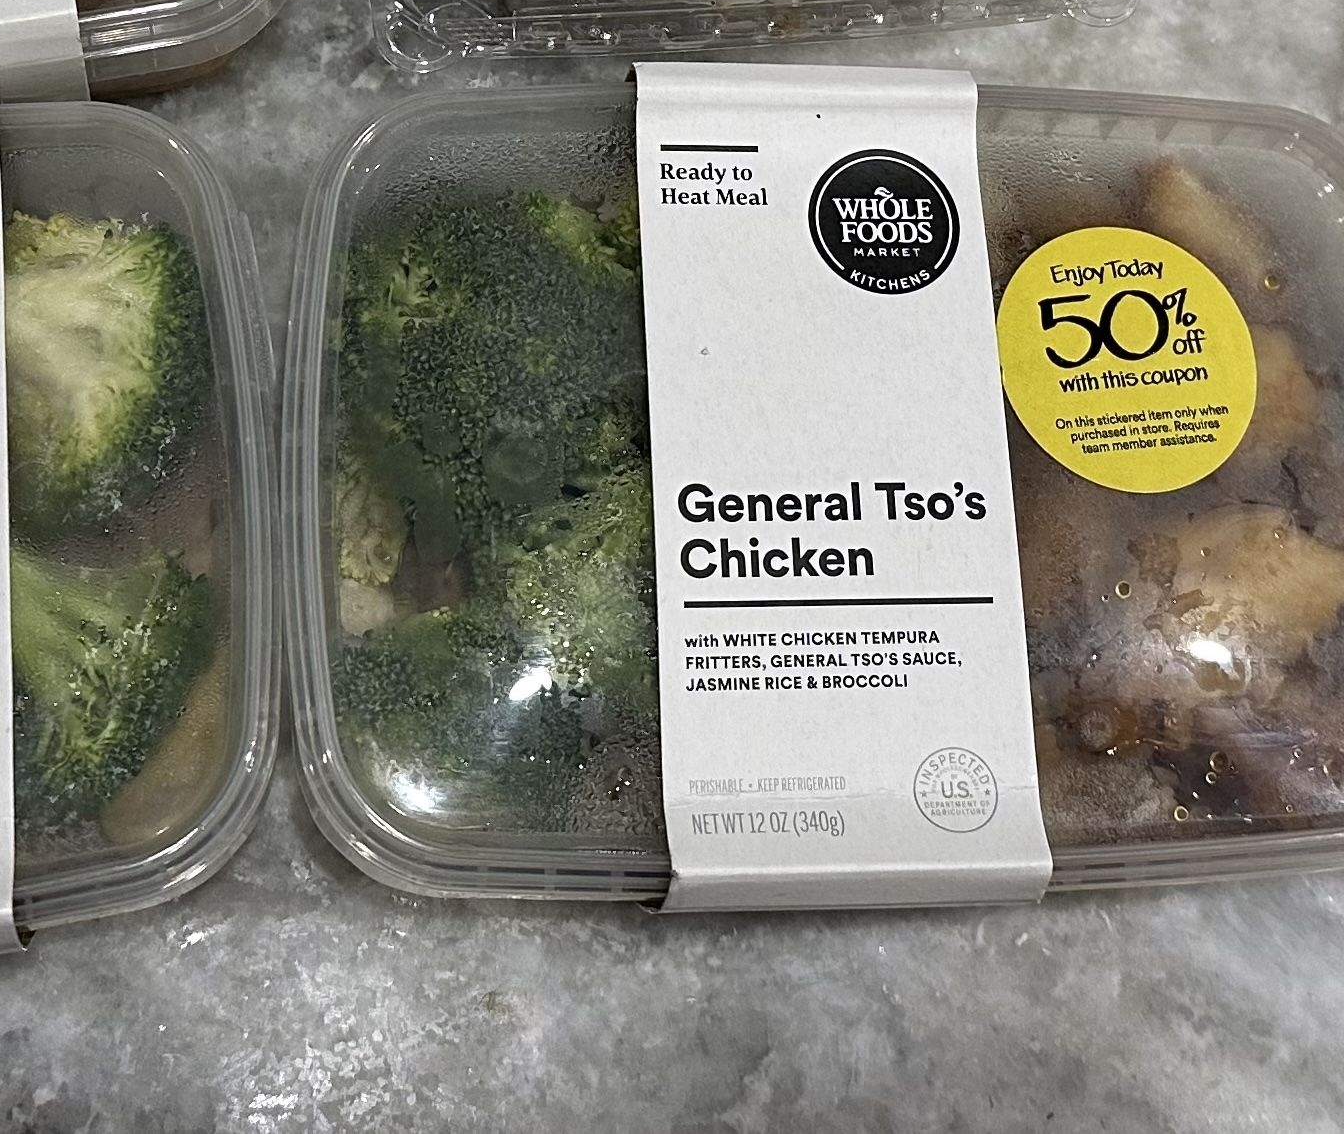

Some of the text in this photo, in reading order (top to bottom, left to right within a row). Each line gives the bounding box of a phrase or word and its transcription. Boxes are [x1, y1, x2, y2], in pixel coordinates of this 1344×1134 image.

[660, 162, 753, 184] Ready to
[660, 188, 768, 206] Heat Meal
[832, 197, 933, 220] WHOLE
[841, 222, 933, 244] FOODS
[854, 247, 920, 257] MARKET
[850, 269, 931, 290] KITCHENS
[1050, 259, 1163, 286] Enjoy Today
[1038, 288, 1206, 369] 50% off
[1060, 366, 1208, 393] with this coupon
[1056, 404, 1228, 429] On this stickered item only when
[1071, 419, 1220, 443] purchased in store. Requires
[1082, 434, 1217, 454] team member assistance.
[677, 482, 987, 523] General Tso’s
[680, 537, 875, 578] Chicken
[685, 630, 940, 648] with WHITE CHICKEN TEMPURA
[686, 652, 962, 670] FRITTERS, GENERAL TSO’S SAUCE,
[686, 674, 908, 692] JASMINE RICE & BROCCOLI
[920, 752, 990, 785] INSPECTED
[689, 776, 846, 794] PERISHABLE KEEP REFRIGERATED
[941, 780, 973, 798] U.S.
[692, 810, 845, 837] NET WT 12 OZ (340g)
